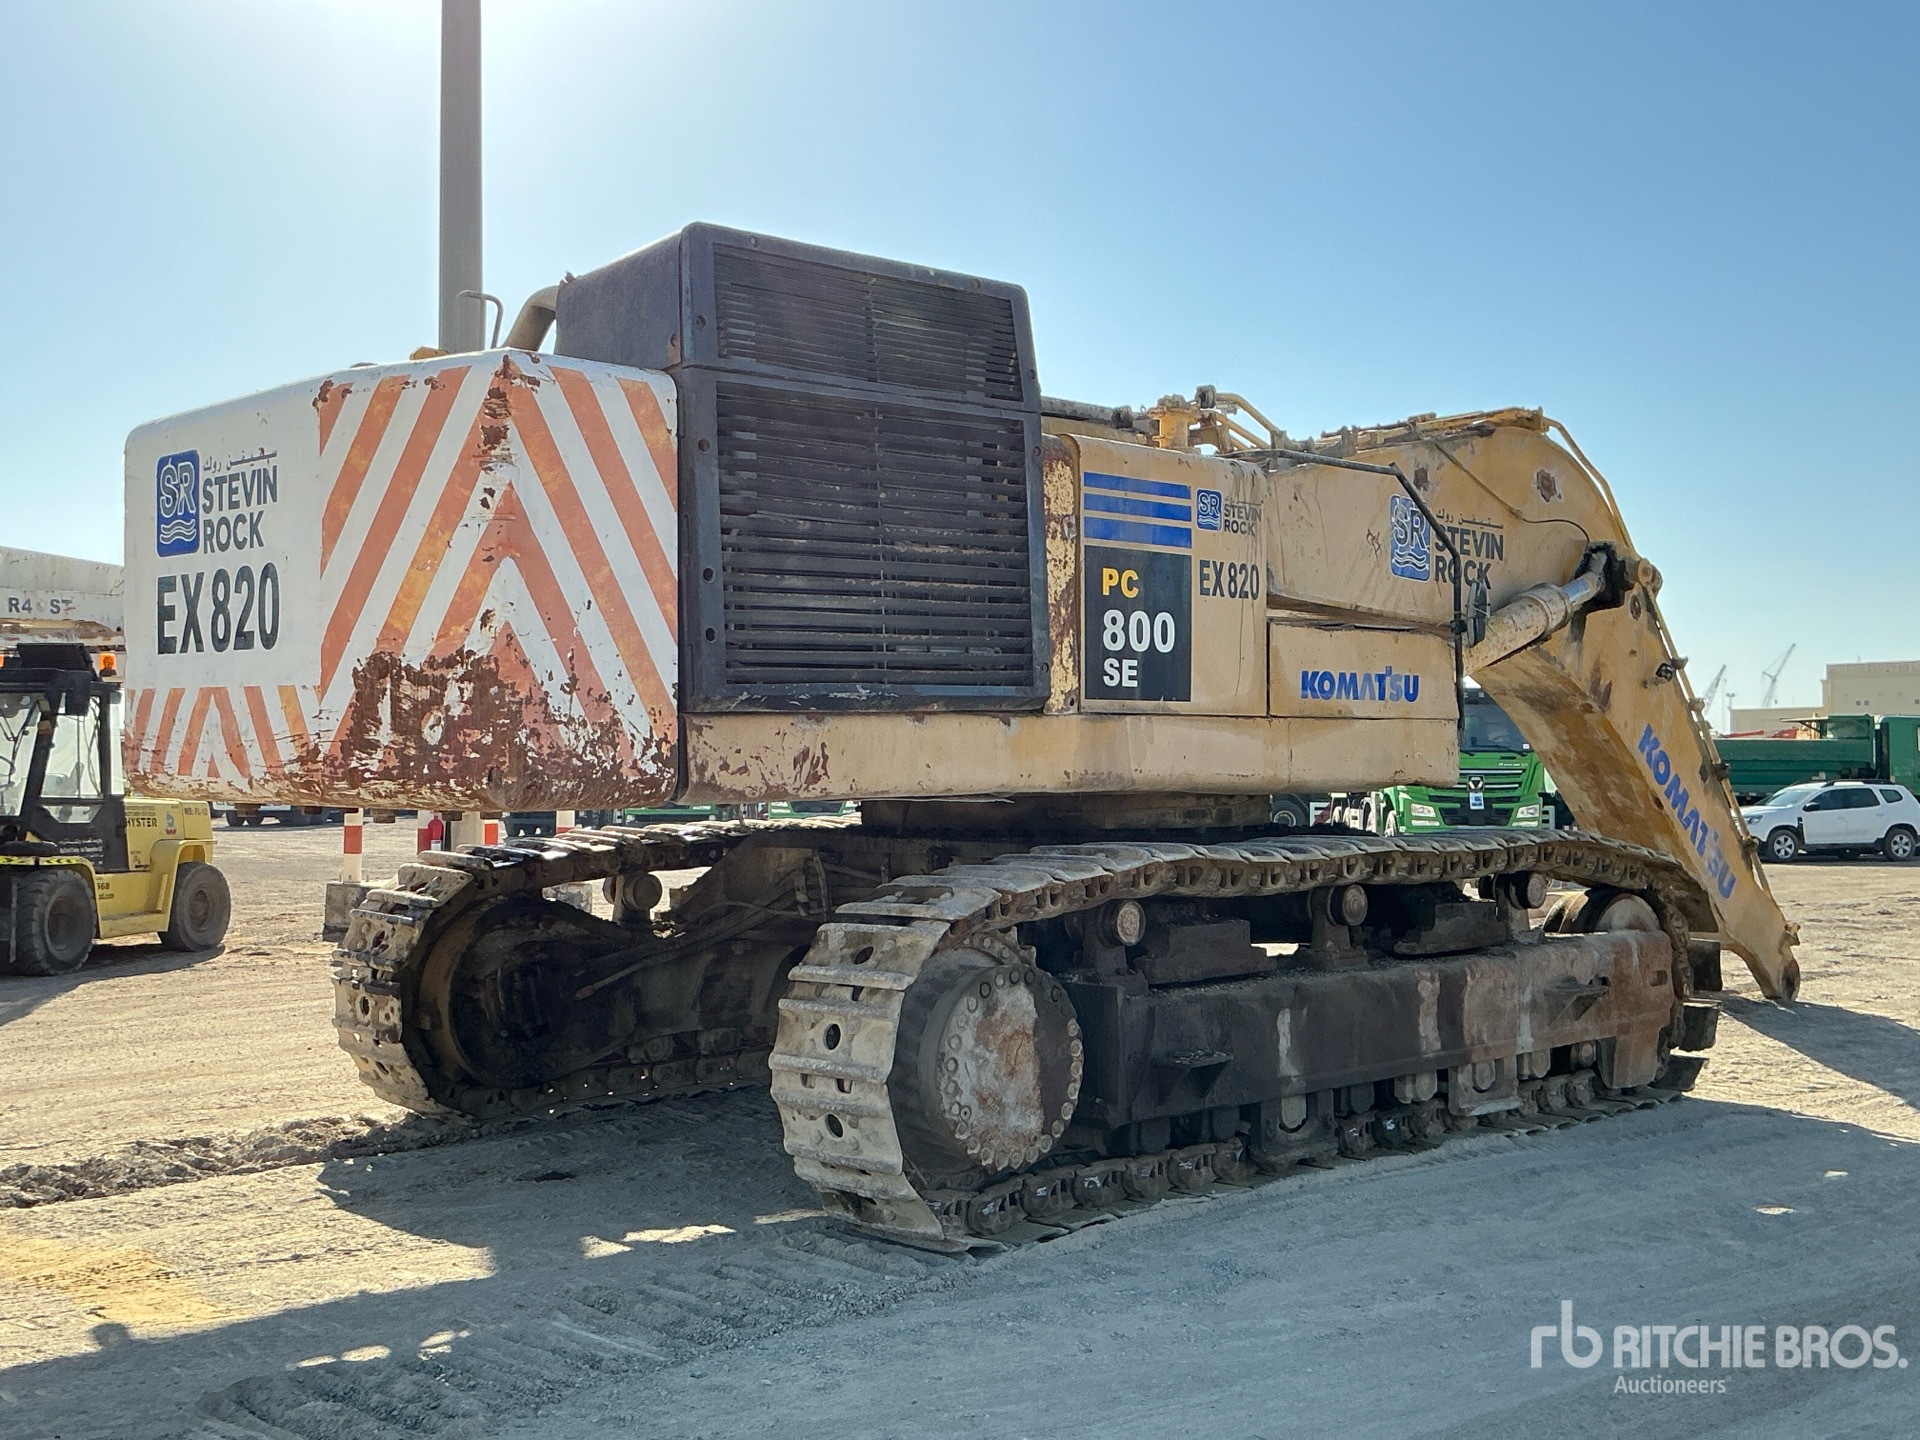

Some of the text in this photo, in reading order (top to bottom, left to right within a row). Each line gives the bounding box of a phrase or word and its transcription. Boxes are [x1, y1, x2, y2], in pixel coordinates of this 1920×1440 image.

[202, 465, 278, 514] STEVIN
[203, 510, 265, 555] ROCK
[1224, 503, 1262, 522] STEVIN
[1224, 519, 1255, 536] ROCK
[1434, 524, 1504, 562] STEVIN
[1102, 567, 1139, 598] PC
[1199, 559, 1260, 601] EX820
[157, 562, 280, 655] EX820
[1102, 609, 1176, 653] 800
[1102, 657, 1139, 688] SE
[1301, 666, 1420, 702] KOMATSU
[1638, 723, 1736, 899] KOMATSU
